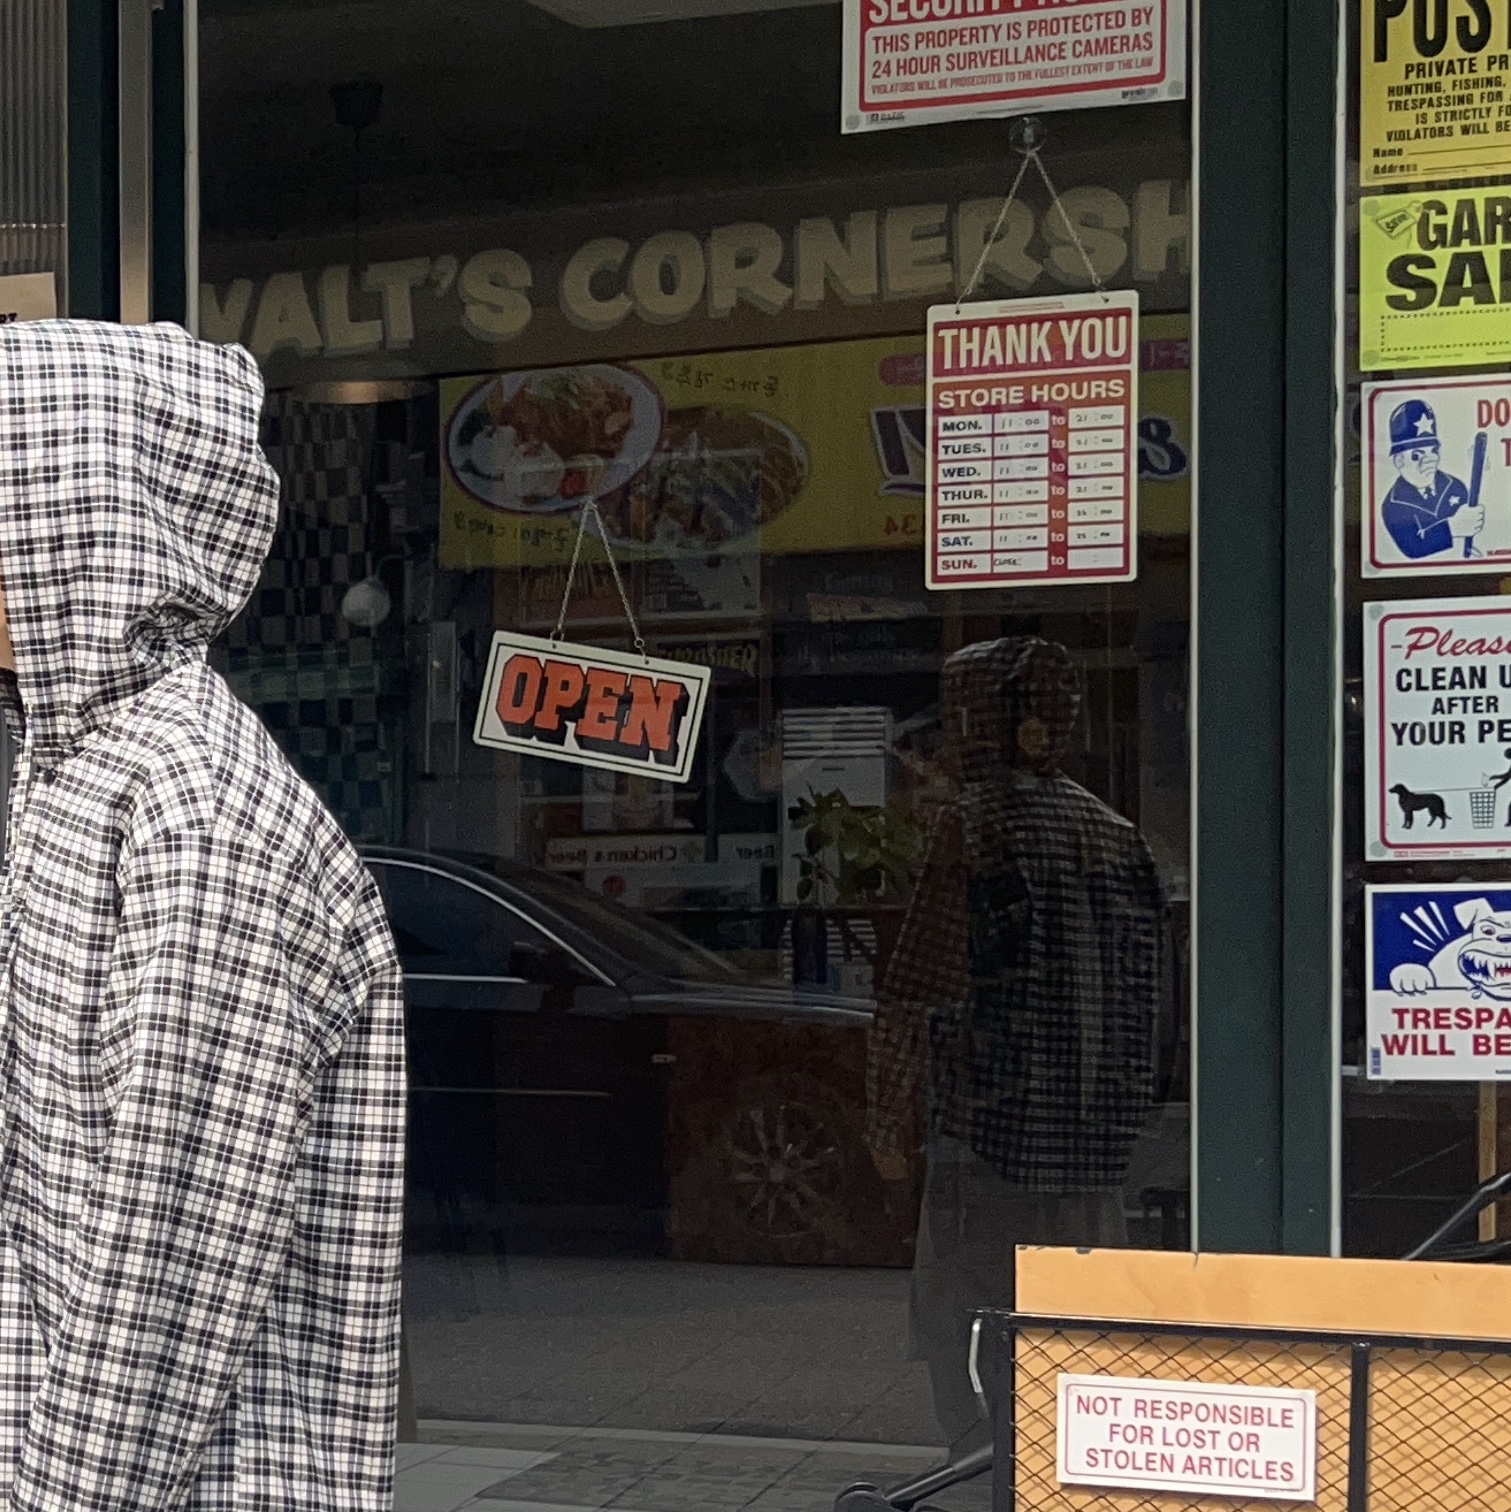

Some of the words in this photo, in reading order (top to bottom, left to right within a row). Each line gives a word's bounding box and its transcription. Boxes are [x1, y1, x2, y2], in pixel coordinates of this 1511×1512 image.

[872, 34, 909, 54] THIS
[915, 24, 1002, 49] PROPERTY
[1007, 21, 1022, 41] IS
[1027, 10, 1125, 38] PROTECTED
[1131, 7, 1153, 27] BY
[1374, 0, 1511, 63] POS
[872, 61, 892, 79] 24
[896, 54, 940, 76] HOUR
[946, 41, 1066, 71] SURVEILLANCE
[1072, 32, 1153, 59] CAMERAS
[1404, 57, 1478, 79] PRIVATE
[1387, 81, 1446, 97] HUNTING,
[1452, 75, 1507, 91] FISHING,
[1387, 93, 1474, 112] TRESPASSING
[1480, 91, 1503, 104] FOR
[1415, 112, 1428, 125] IS
[1434, 107, 1492, 123] STRICTLY
[1386, 125, 1454, 142] VIOLATORS
[1460, 122, 1490, 136] WILL
[938, 320, 1052, 369] THANK
[1058, 315, 1127, 362] YOU
[938, 386, 1024, 409] STORE
[1031, 379, 1125, 403] HOURS
[942, 420, 982, 432] MON.
[1052, 414, 1066, 425] to
[942, 443, 986, 455] TUES.
[1052, 438, 1066, 449] to
[942, 466, 981, 479] WED.
[1052, 462, 1066, 472] to
[942, 489, 988, 501] THUR.
[1051, 485, 1065, 496] to
[942, 513, 970, 525] FRI.
[1051, 509, 1065, 519] to
[942, 536, 973, 547] SAT.
[1051, 532, 1065, 542] to
[942, 559, 977, 570] SUN.
[1051, 555, 1065, 565] to
[1403, 625, 1511, 661] Pleas
[1396, 666, 1486, 692] CLEAN
[496, 654, 690, 764] OPEN
[1431, 695, 1499, 715] AFTER
[1391, 720, 1465, 746] YOUR
[1381, 1034, 1455, 1057] WILL
[1473, 1034, 1511, 1056] BE
[1076, 1395, 1122, 1417] NOT
[1134, 1398, 1295, 1429] RESPONSIBLE
[1108, 1423, 1154, 1445] FOR
[1162, 1427, 1221, 1450] LOST
[1228, 1431, 1260, 1453] OR
[1085, 1448, 1175, 1474] STOLEN
[1181, 1454, 1294, 1482] ARTICLES
